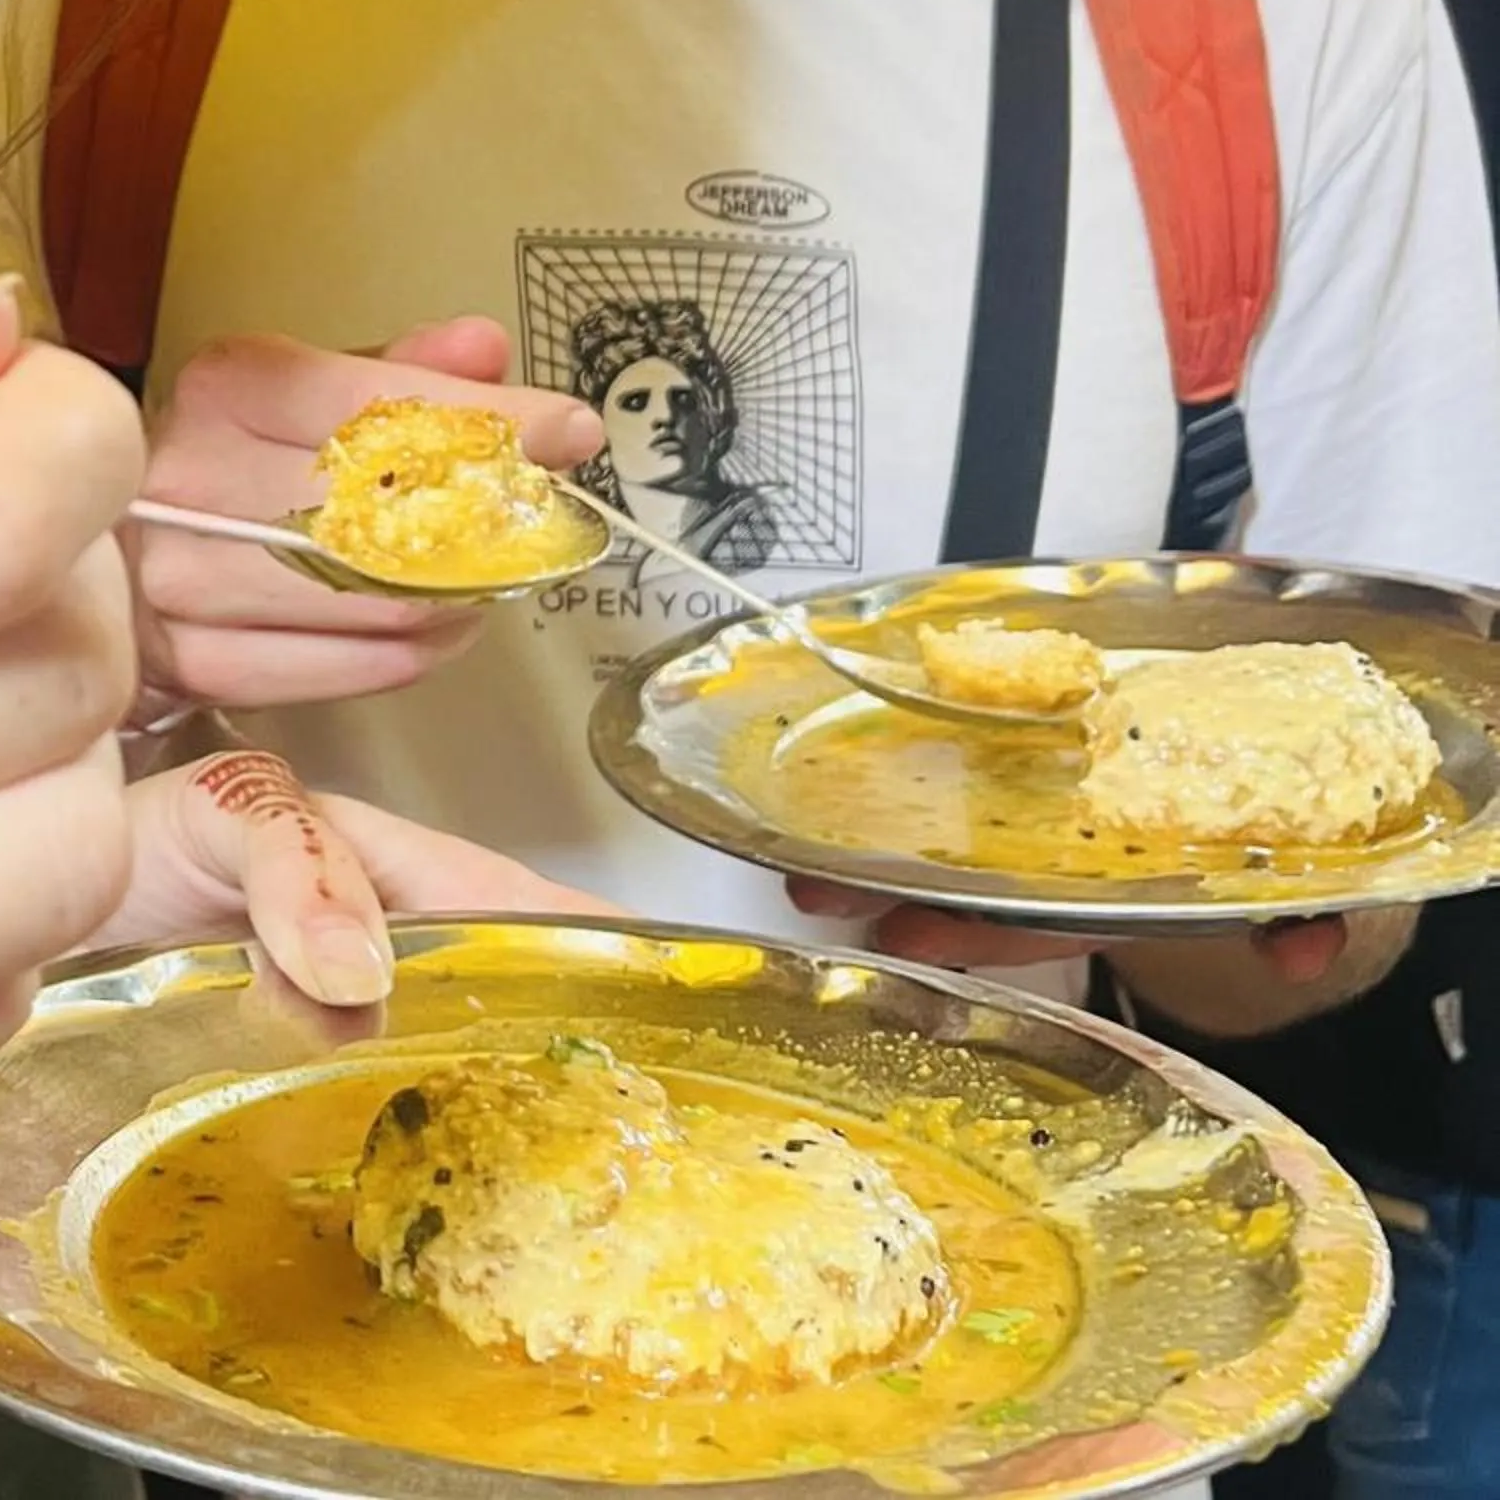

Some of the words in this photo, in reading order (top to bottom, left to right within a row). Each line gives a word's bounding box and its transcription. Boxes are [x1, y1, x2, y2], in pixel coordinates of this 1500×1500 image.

[698, 184, 808, 205] JEFFERSON
[719, 200, 789, 217] DREAM
[538, 585, 642, 618] OPEN
